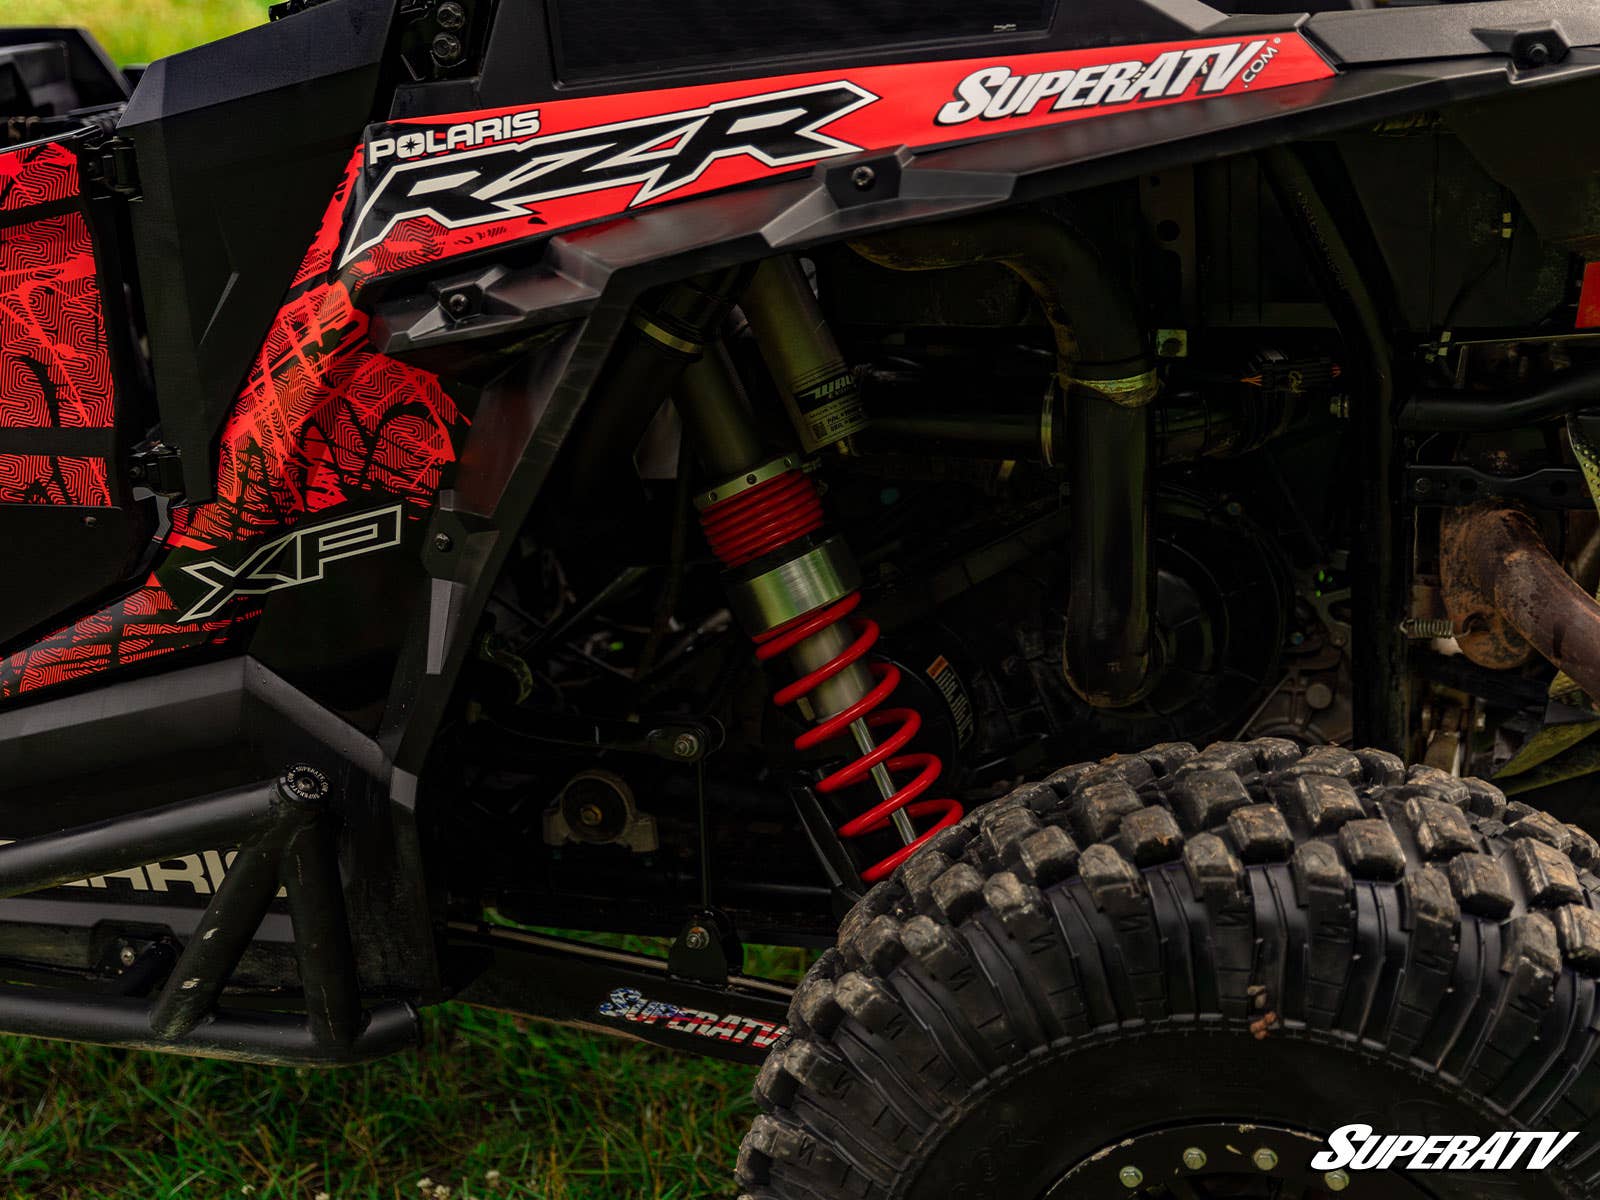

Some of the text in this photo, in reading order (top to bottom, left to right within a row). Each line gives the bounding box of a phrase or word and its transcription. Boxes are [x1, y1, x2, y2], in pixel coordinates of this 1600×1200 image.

[935, 39, 1270, 126] SUPERATV
[339, 79, 881, 269] RZR
[370, 108, 541, 165] POLARIS
[176, 504, 403, 624] XP
[598, 986, 789, 1049] SUPERATV
